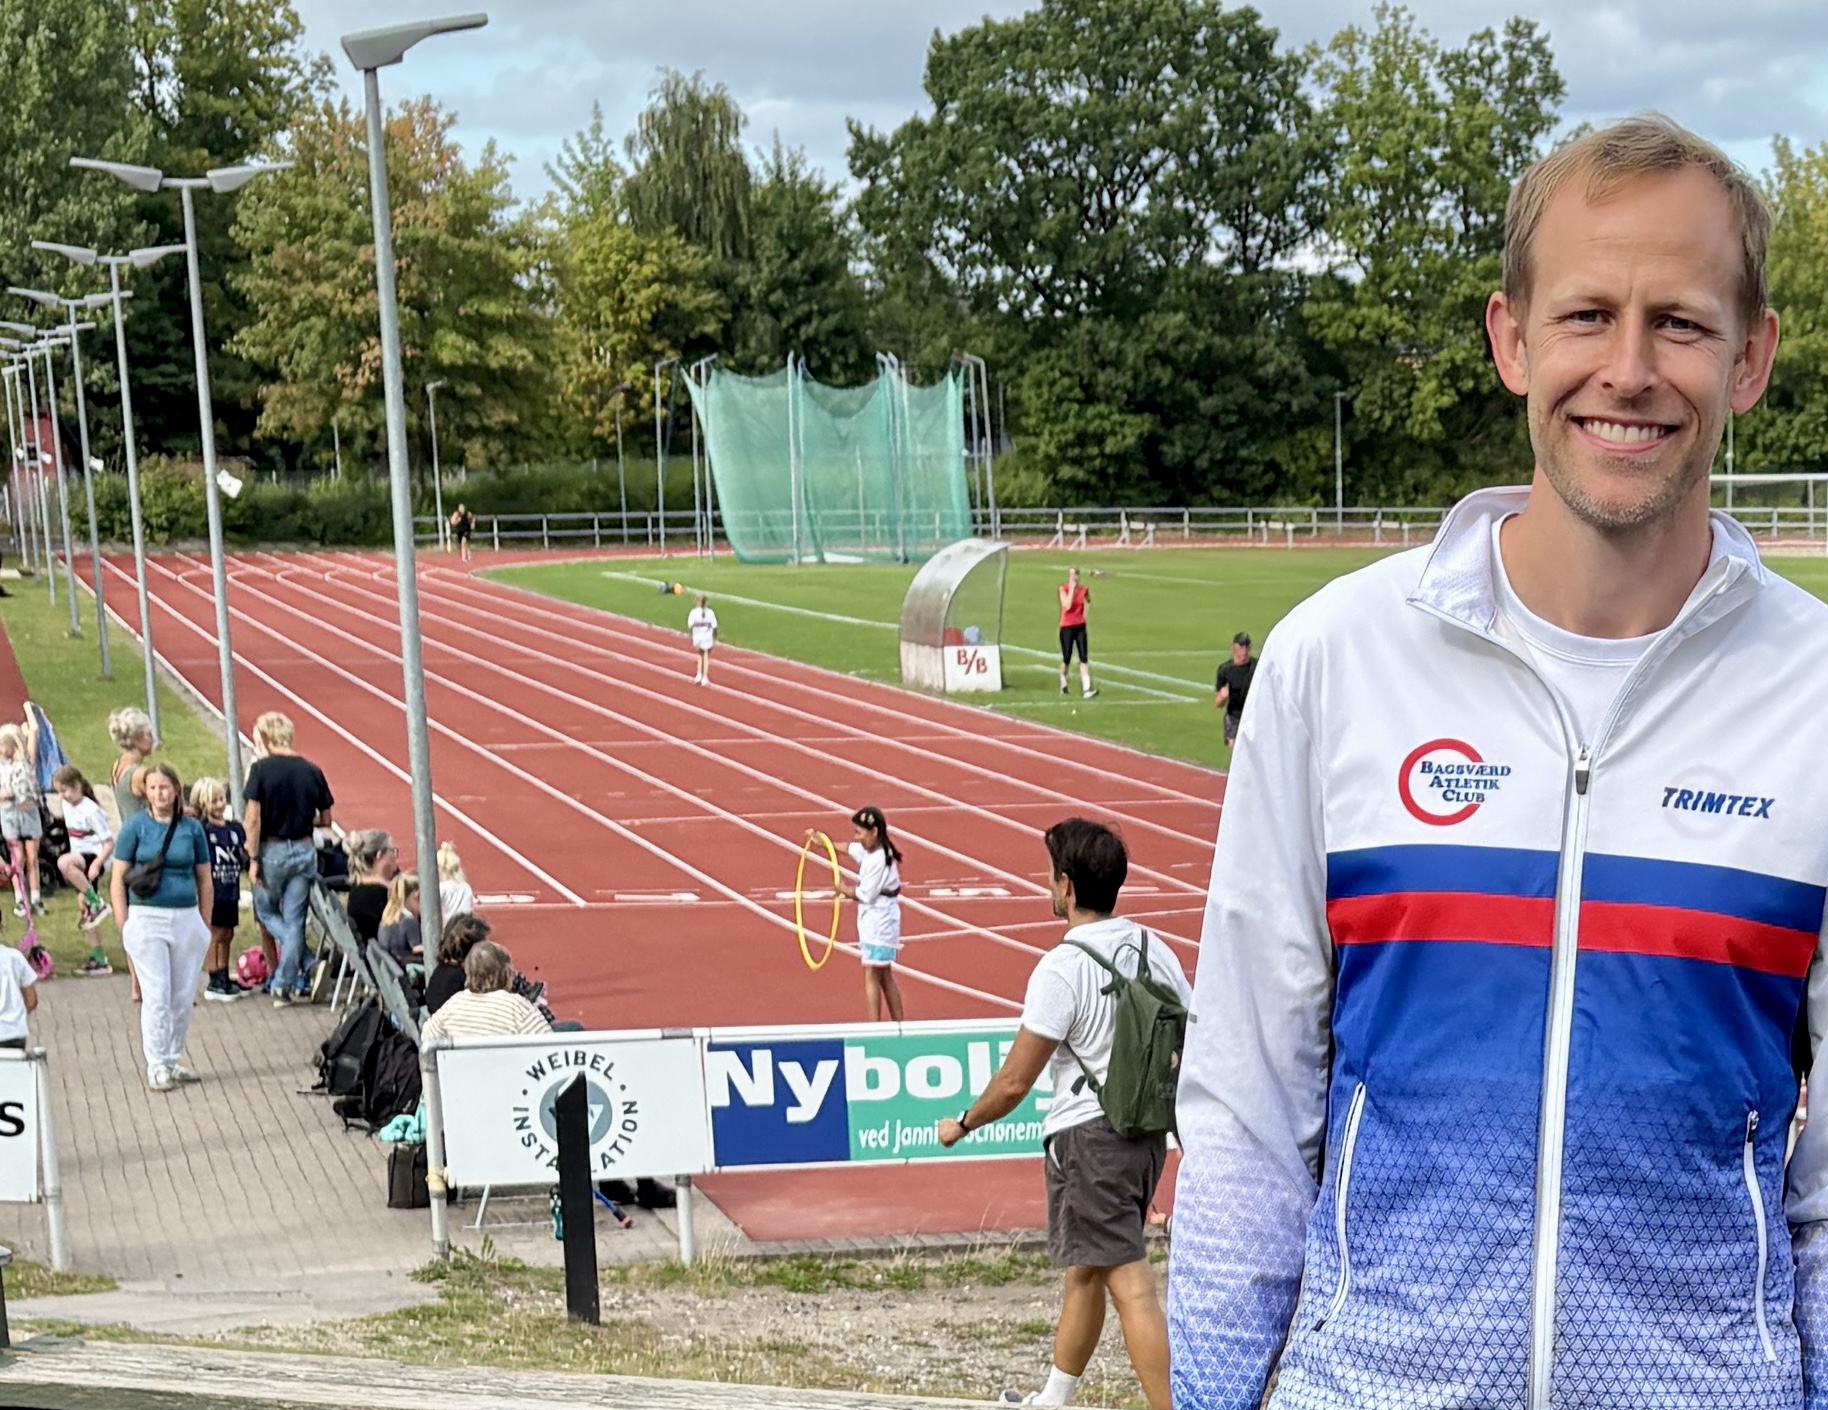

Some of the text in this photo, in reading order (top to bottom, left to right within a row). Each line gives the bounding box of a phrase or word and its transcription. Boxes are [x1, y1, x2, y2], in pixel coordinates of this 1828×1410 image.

[1662, 787, 1775, 819] TRIMTEX
[525, 1050, 614, 1081] WEIBEL
[708, 1040, 1054, 1123] Nybol
[859, 1120, 889, 1149] ved
